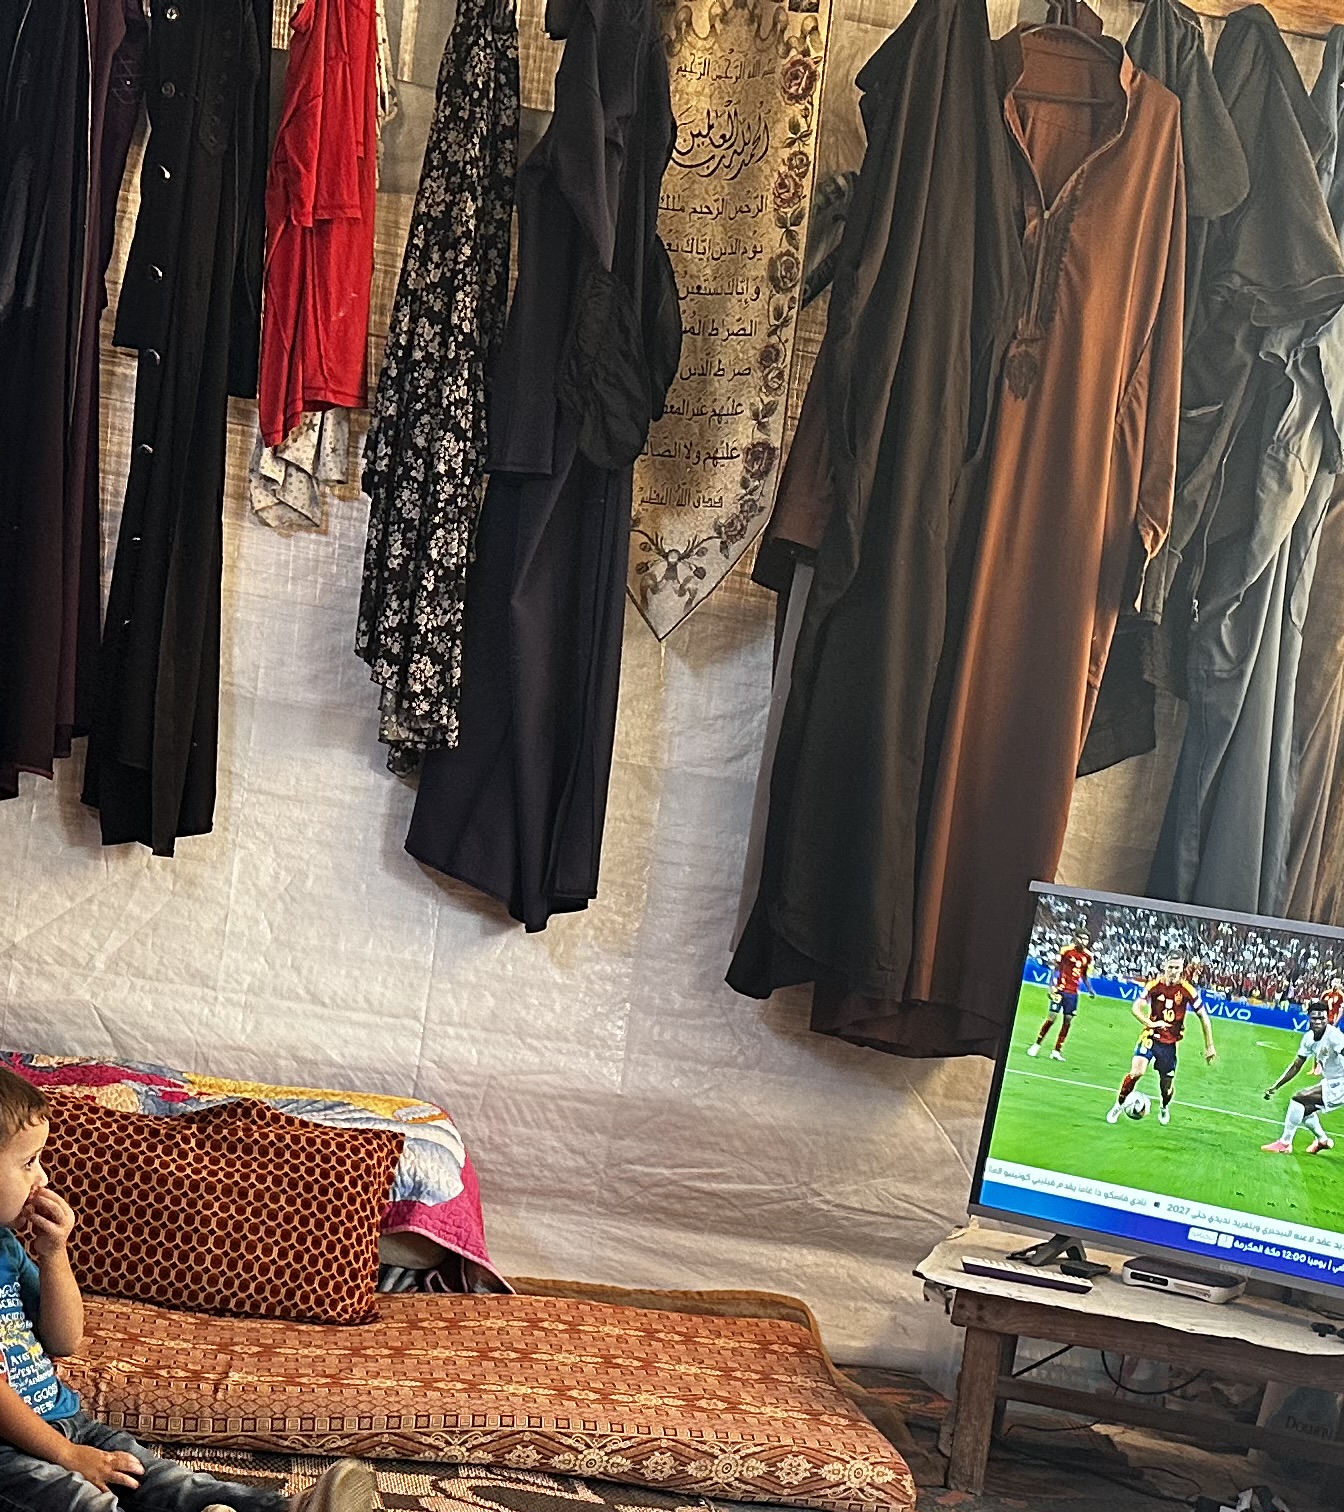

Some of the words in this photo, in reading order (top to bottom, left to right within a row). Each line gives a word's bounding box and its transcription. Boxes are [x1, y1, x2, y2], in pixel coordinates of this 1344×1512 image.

[1204, 1001, 1252, 1020] vivo
[1166, 1203, 1191, 1215] 2027
[1281, 1249, 1307, 1263] 12:00
